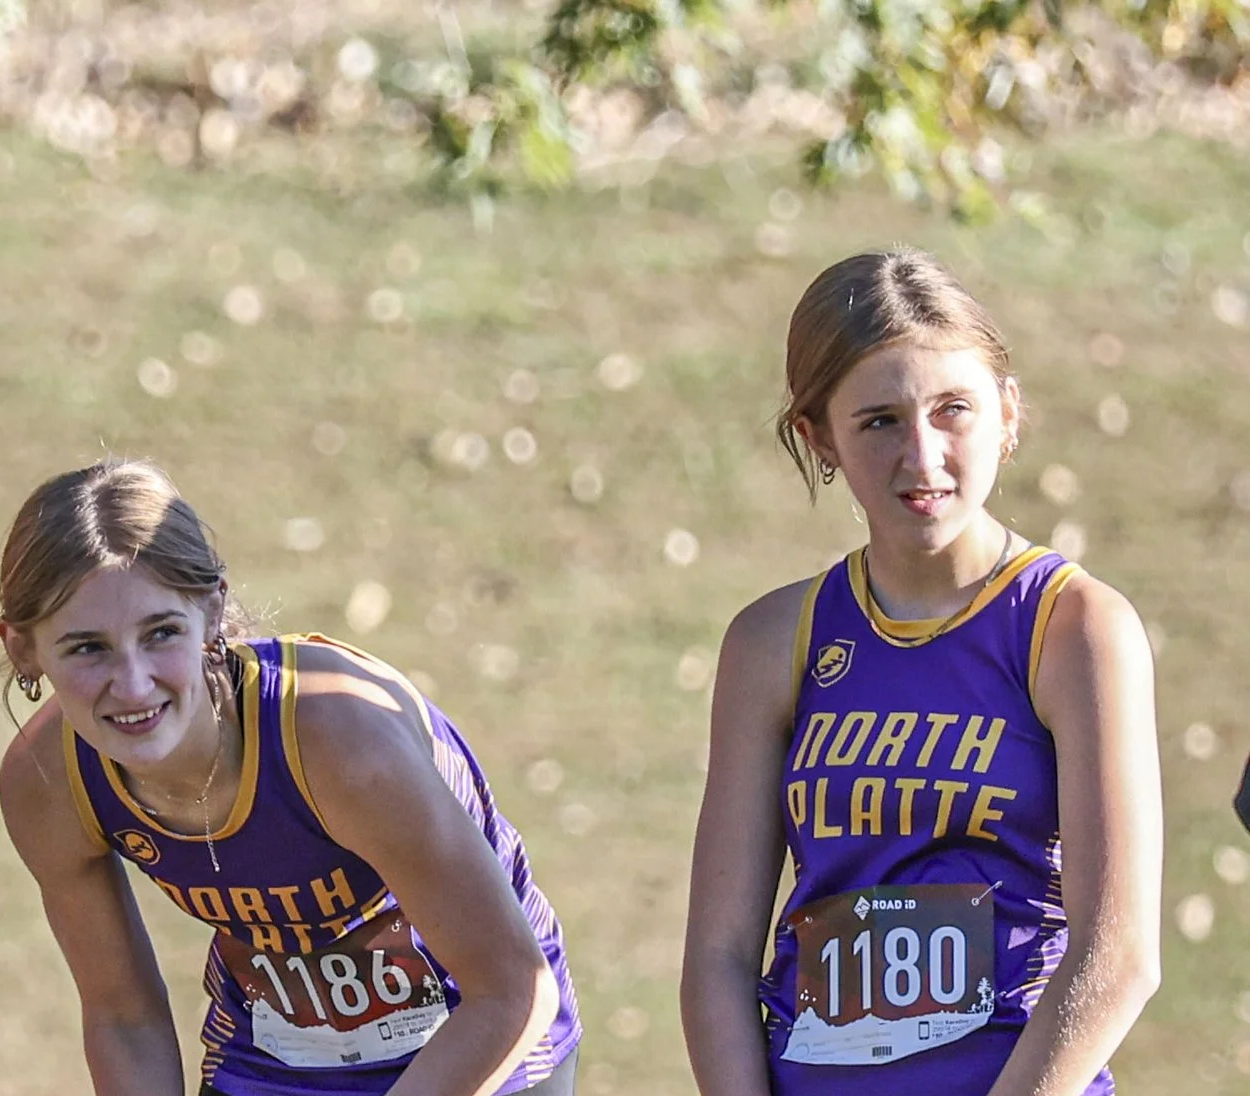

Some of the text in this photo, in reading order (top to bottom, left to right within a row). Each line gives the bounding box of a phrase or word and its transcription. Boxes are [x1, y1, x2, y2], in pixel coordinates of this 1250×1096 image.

[792, 711, 1007, 773] NORTH
[787, 777, 1018, 842] PLATTE
[872, 899, 902, 910] ROAD
[251, 949, 412, 1020] 1186
[821, 926, 967, 1017] 1180
